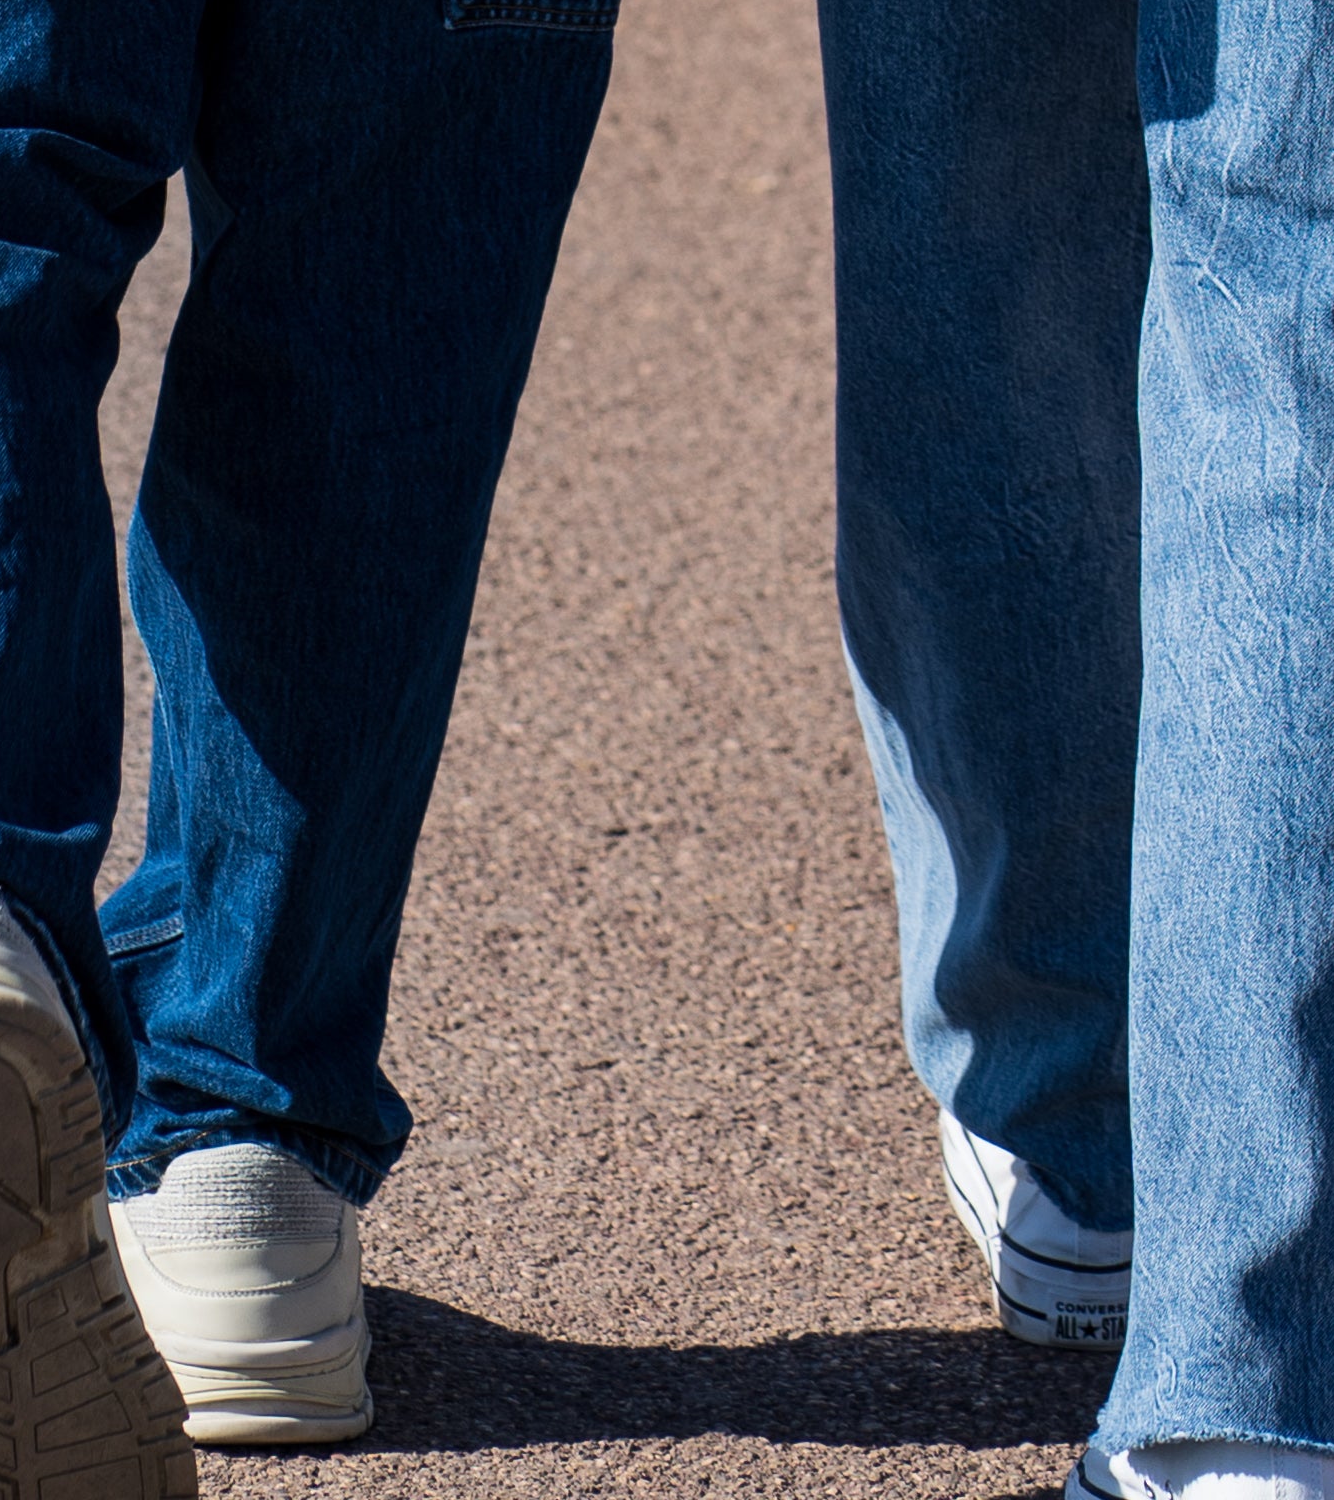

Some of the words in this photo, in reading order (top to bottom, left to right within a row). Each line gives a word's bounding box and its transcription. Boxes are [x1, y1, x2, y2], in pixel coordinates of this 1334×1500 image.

[1055, 1301, 1128, 1315] CONVERS
[1055, 1314, 1079, 1339] ALL
[1101, 1315, 1128, 1340] STA
